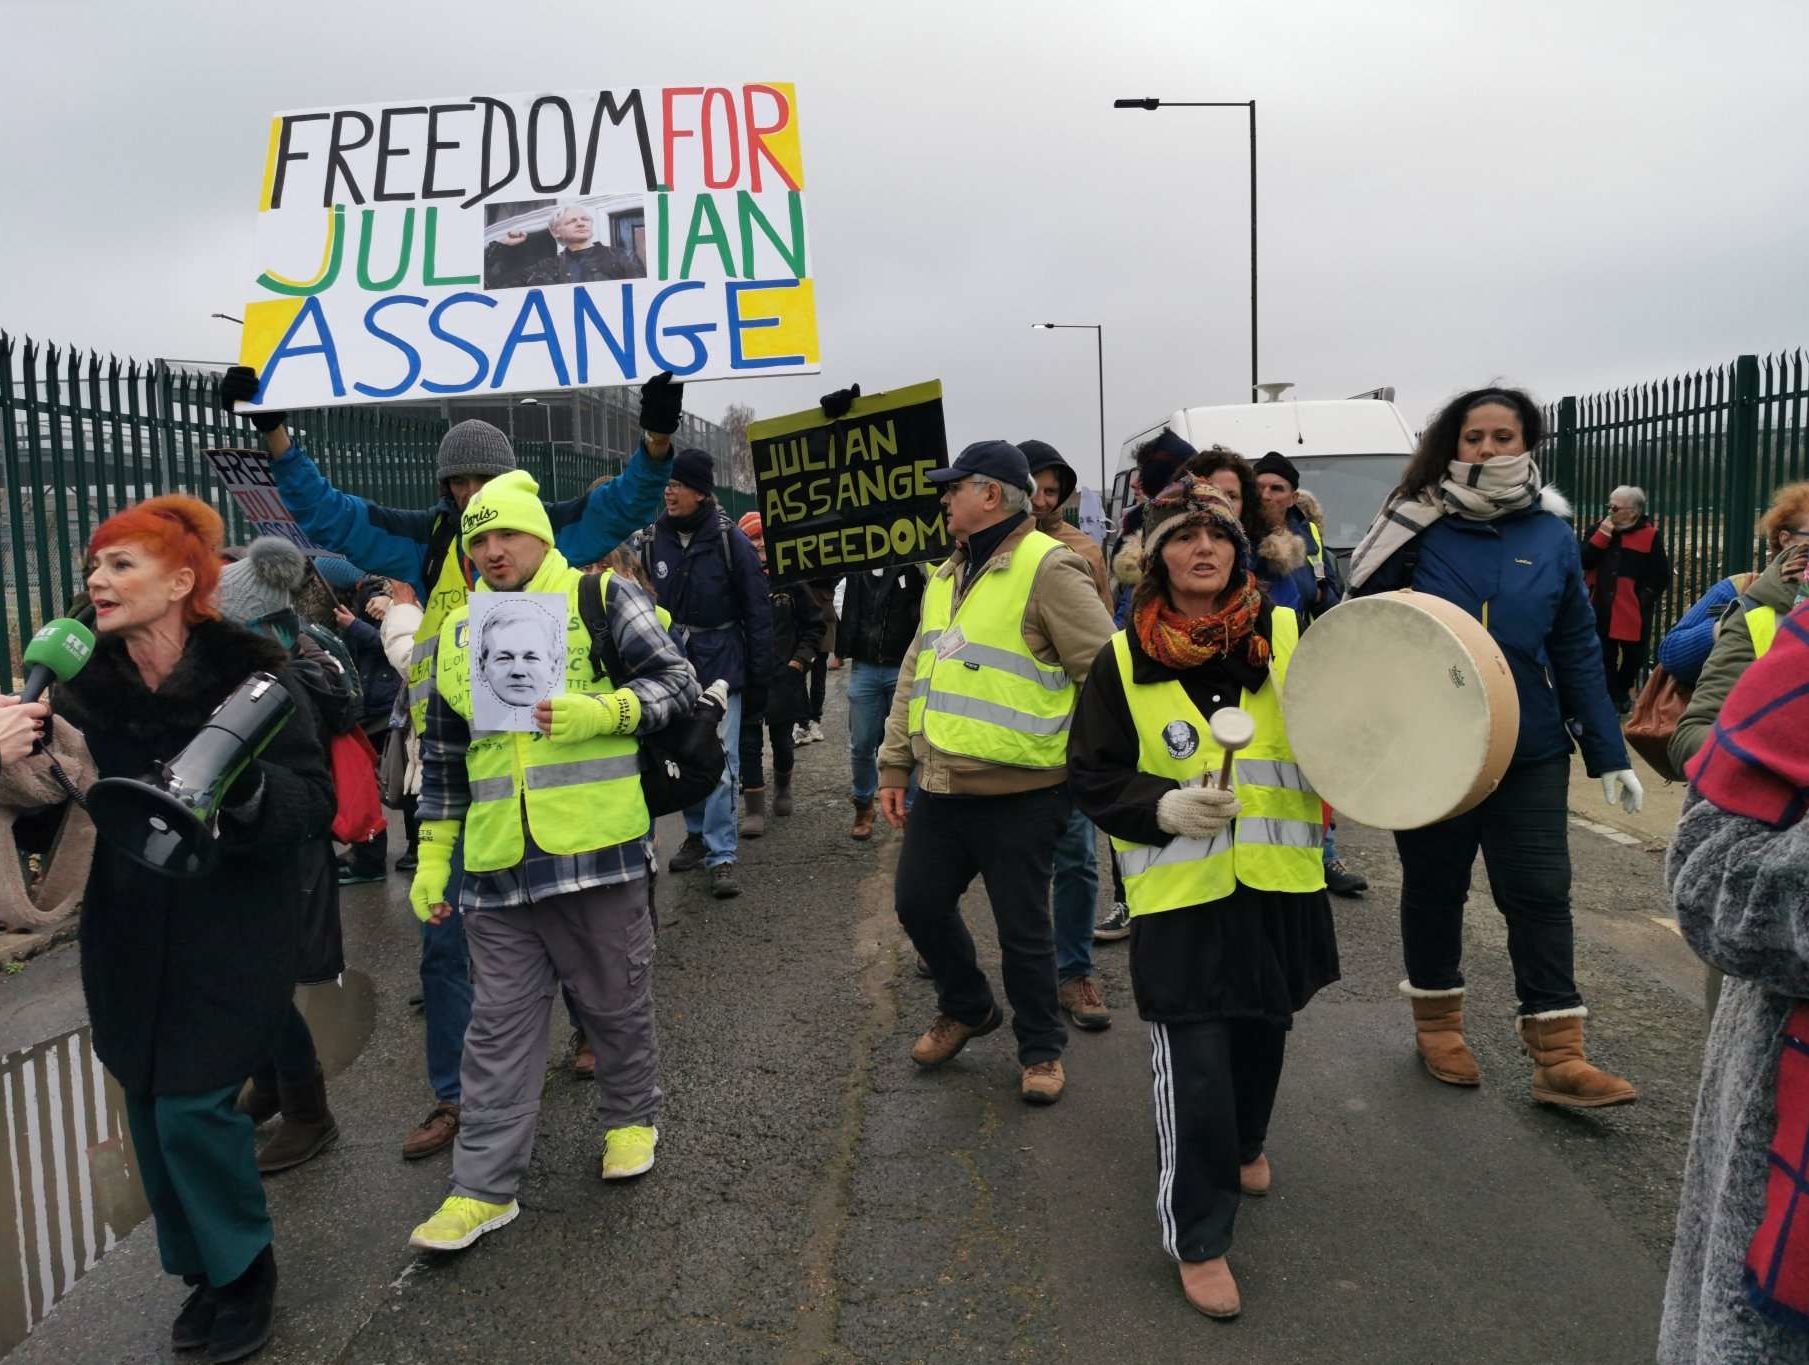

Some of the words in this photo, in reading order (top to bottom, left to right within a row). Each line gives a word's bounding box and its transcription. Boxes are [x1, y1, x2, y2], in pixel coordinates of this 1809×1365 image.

[270, 88, 658, 209] FREEDOM
[661, 84, 803, 193] FOR
[252, 278, 805, 405] ASSANGE
[206, 451, 277, 487] FREE
[759, 419, 898, 481] JULIAN
[462, 505, 499, 535] Paris
[766, 459, 937, 528] ASSANGE
[775, 511, 947, 575] FREEDOM
